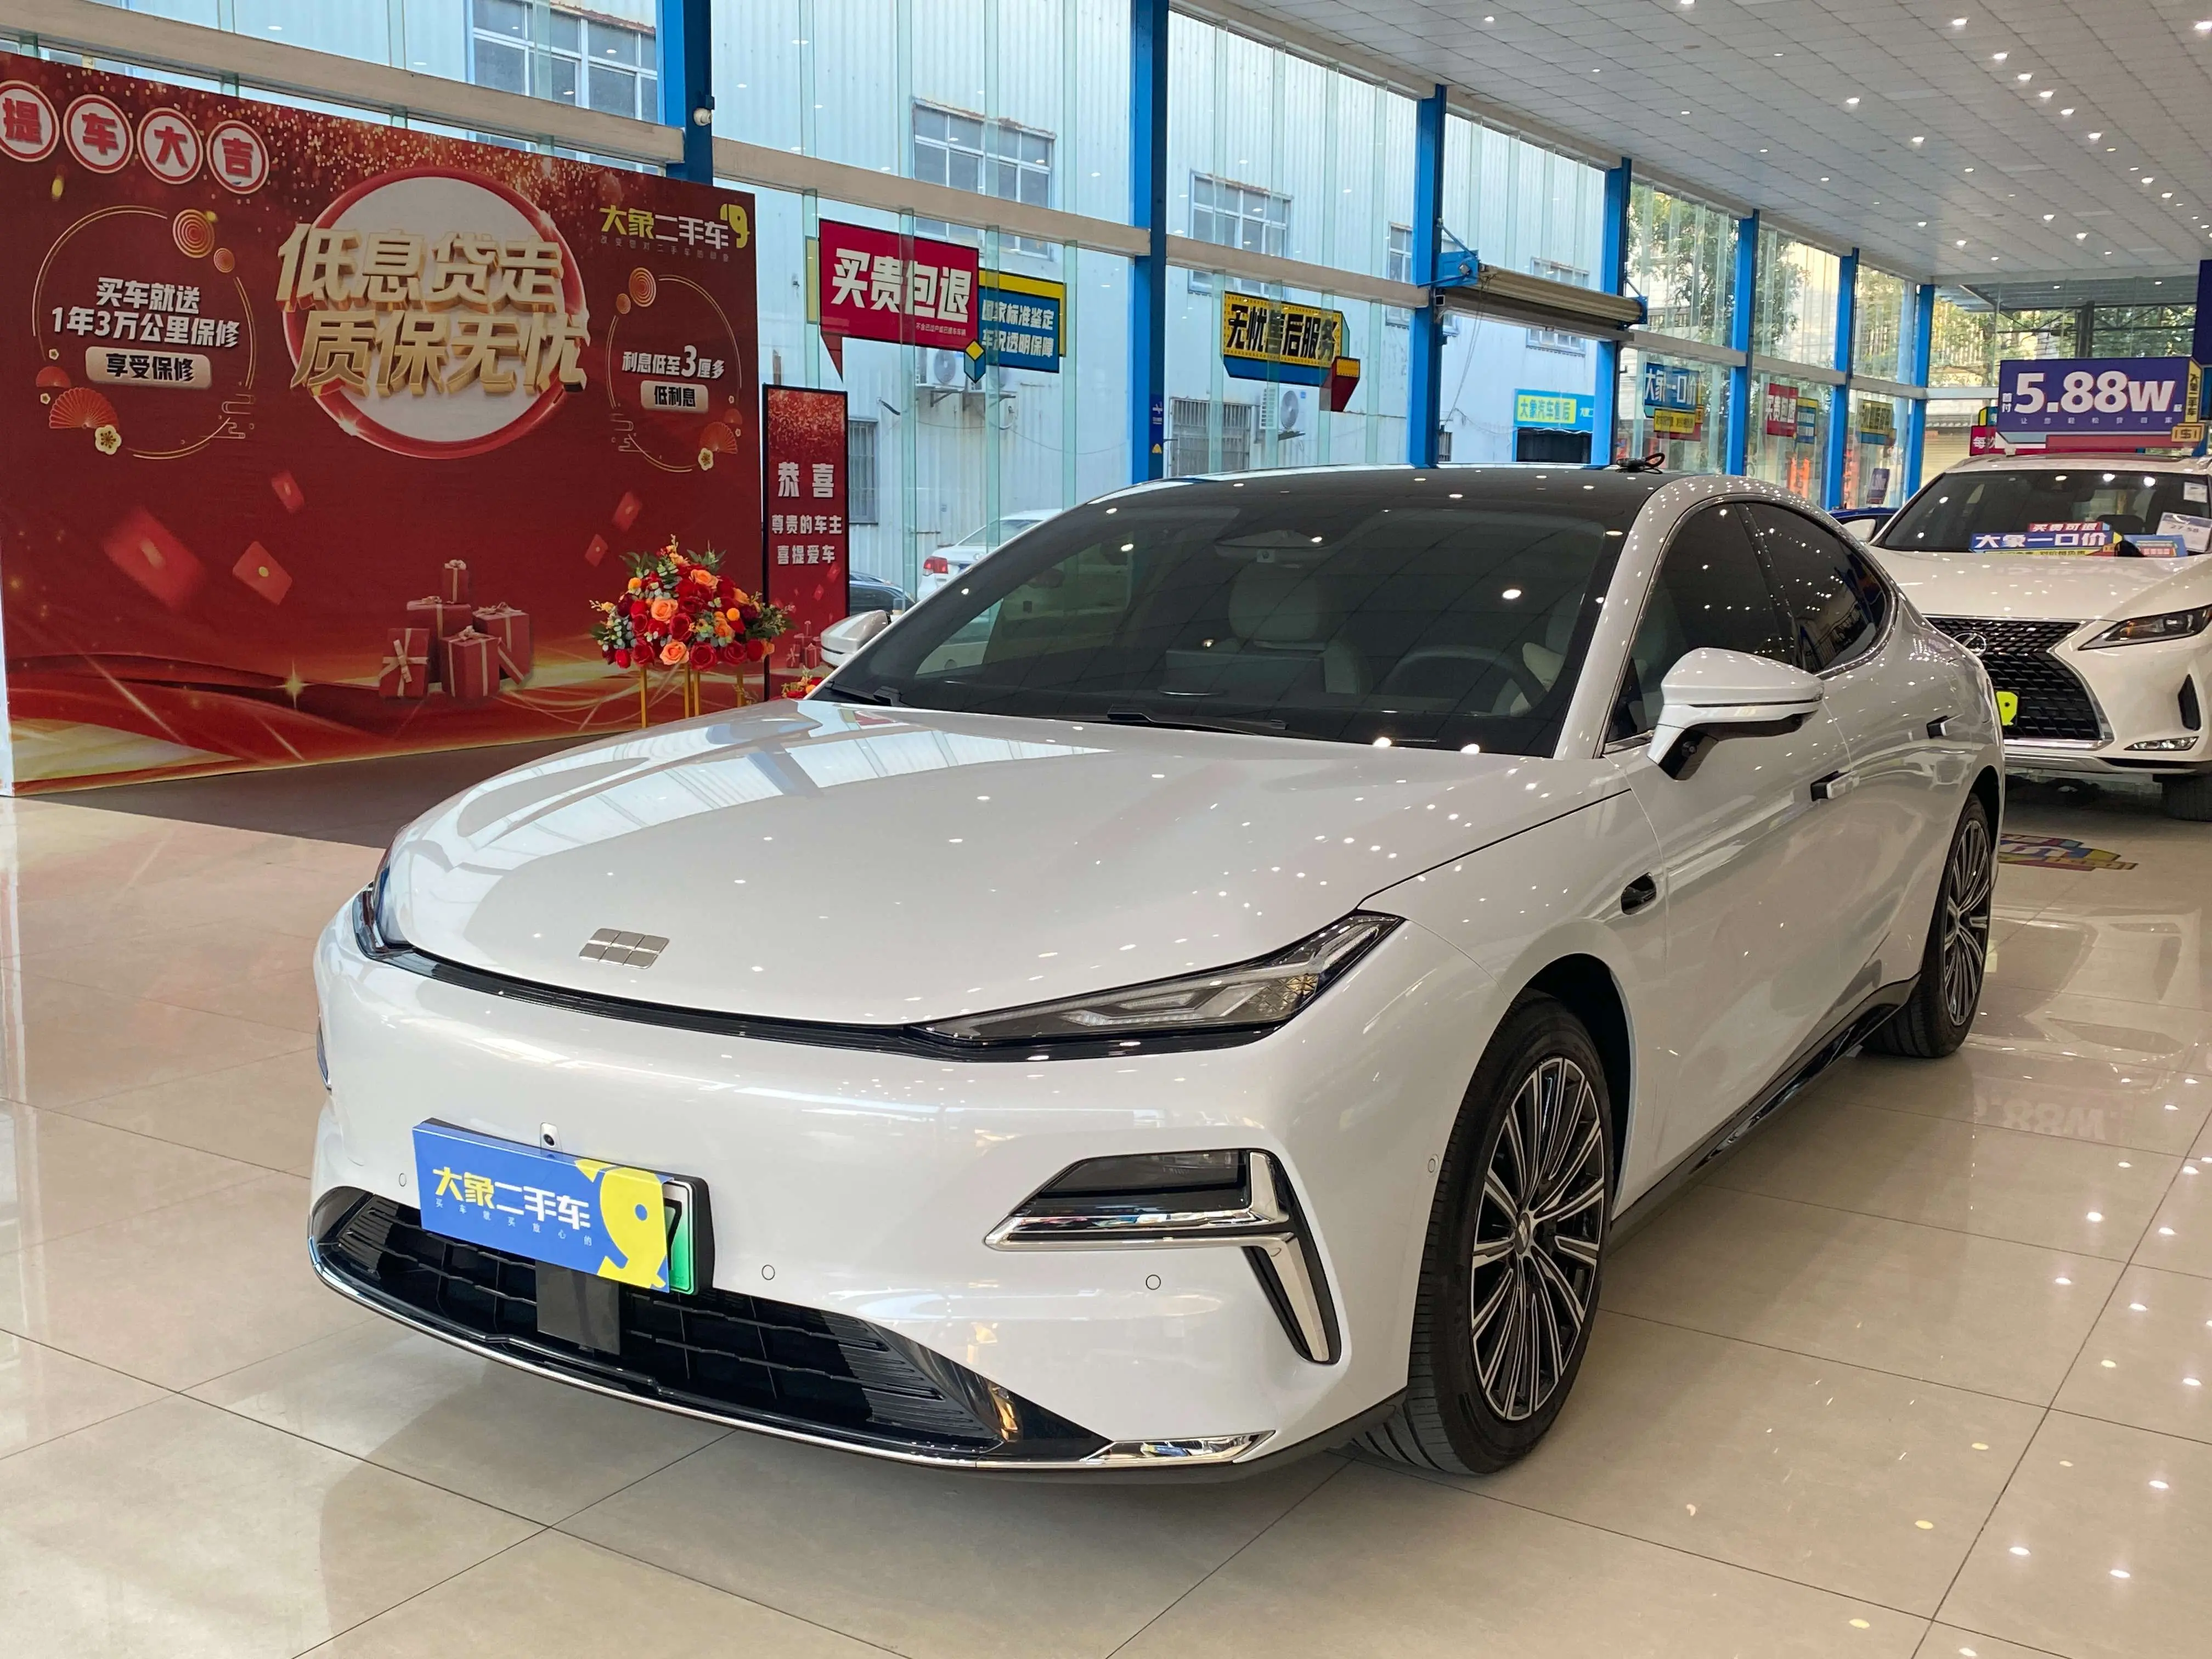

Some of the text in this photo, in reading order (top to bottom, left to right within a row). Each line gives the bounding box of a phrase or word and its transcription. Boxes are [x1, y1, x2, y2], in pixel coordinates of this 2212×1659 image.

[2, 98, 254, 178] 提车大吉
[599, 205, 729, 249] 大象二手车
[276, 223, 564, 313] 低息贷走
[831, 247, 972, 323] 买贵包退
[97, 277, 200, 314] 买车就送
[52, 306, 240, 347] 1年3万公里保修
[982, 299, 1054, 330] 国家标准鉴定
[106, 353, 195, 382] 享受保修
[290, 309, 590, 396] 质保无忧
[622, 345, 724, 379] 利息低至3厘多
[654, 386, 696, 408] 低利息
[778, 462, 834, 498] 恭喜
[771, 515, 843, 534] 尊贵的车主
[1975, 532, 2107, 548] 大象一口价
[777, 545, 836, 565] 喜提爱车
[433, 1166, 590, 1230] 大象二手车
